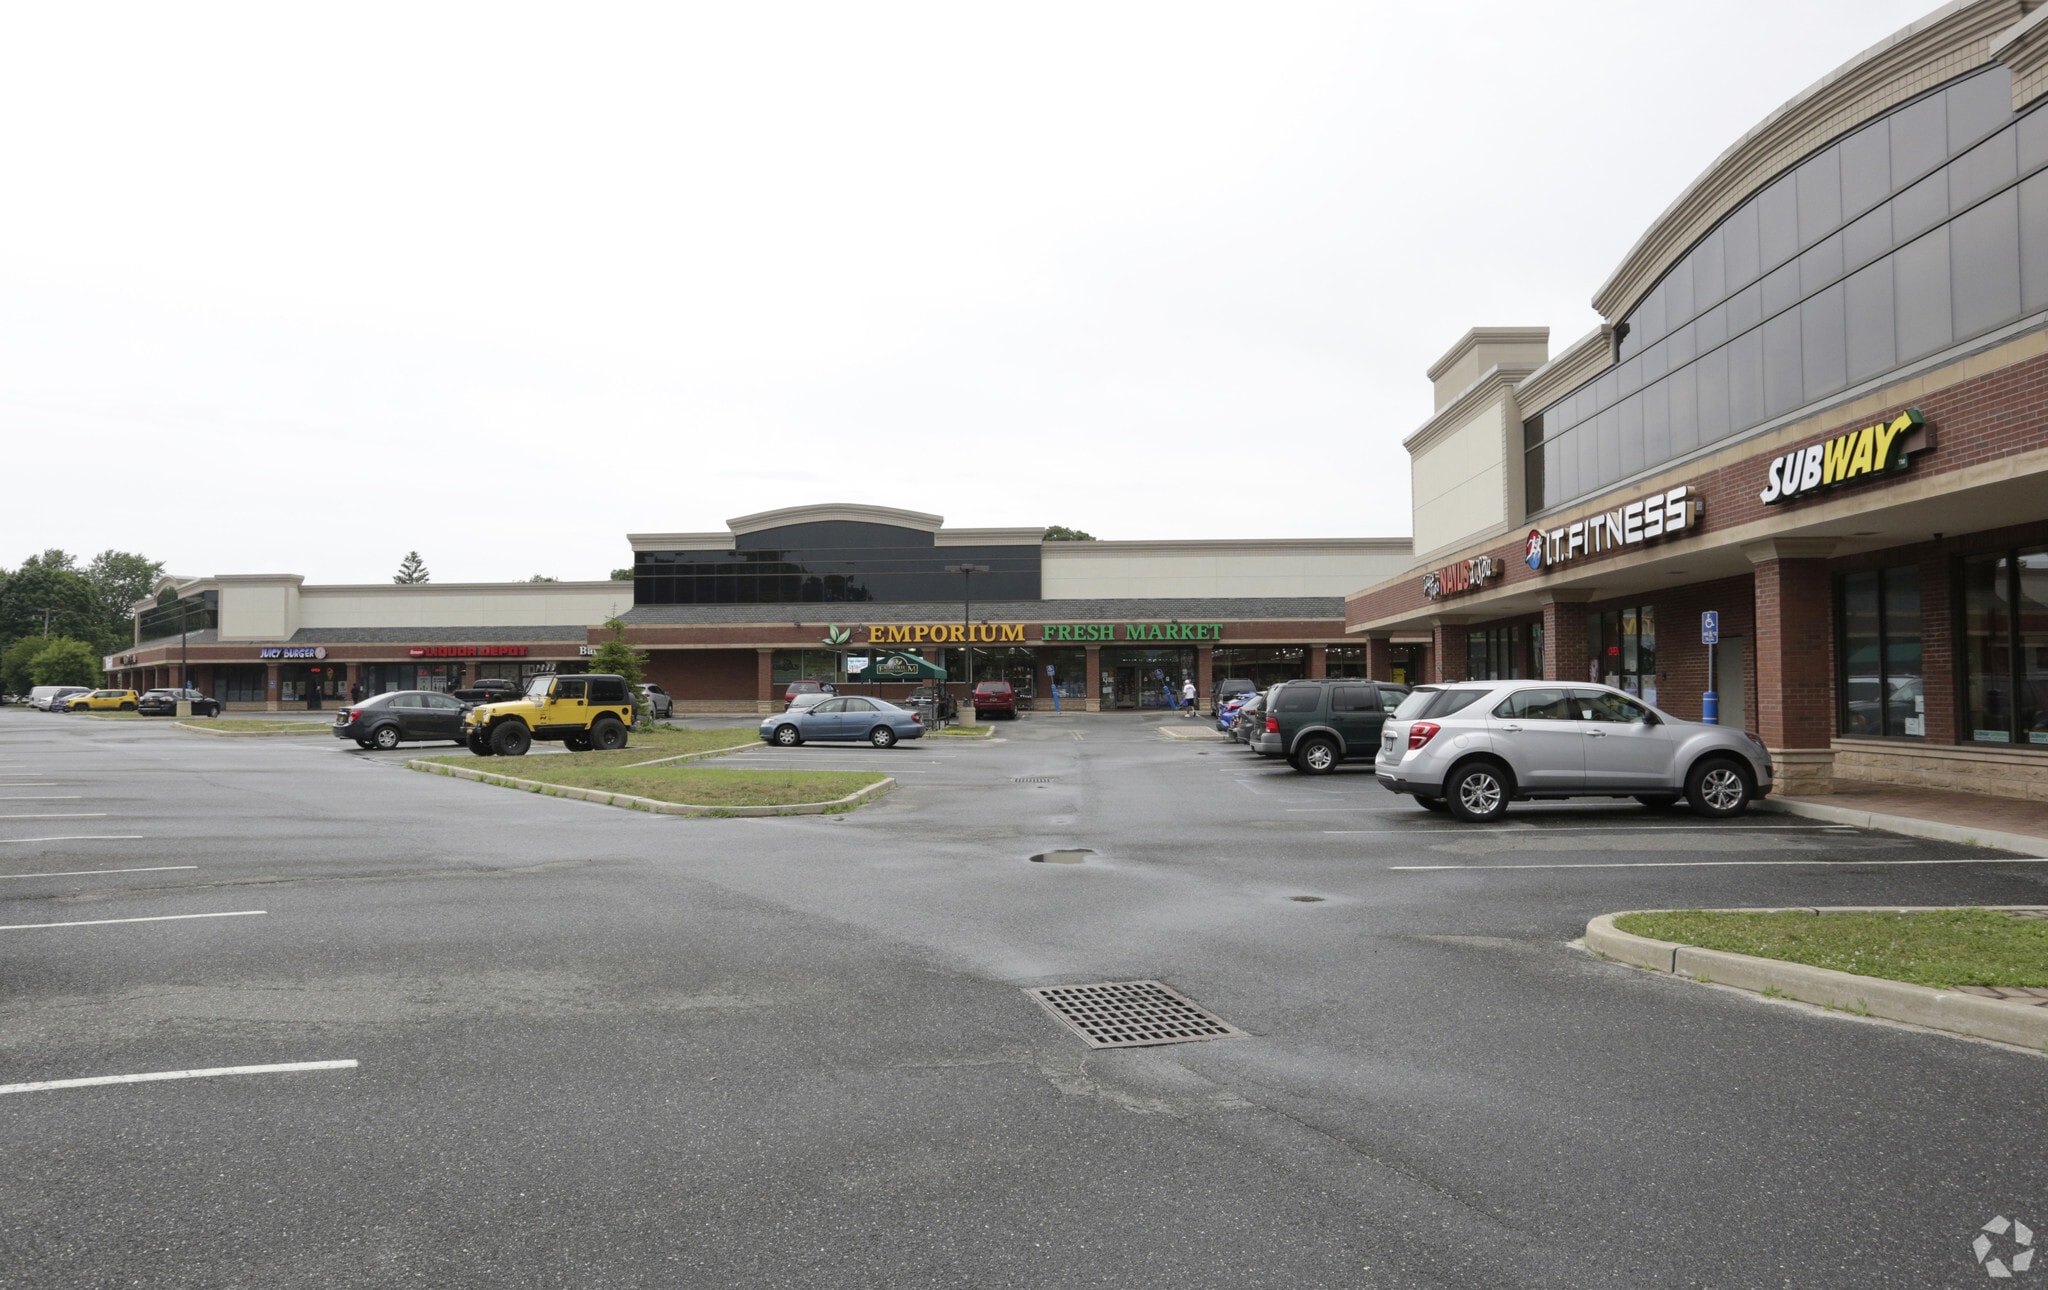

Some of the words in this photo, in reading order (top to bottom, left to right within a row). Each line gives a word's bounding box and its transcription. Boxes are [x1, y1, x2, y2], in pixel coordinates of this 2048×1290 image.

[1760, 410, 1912, 505] SUBWAY
[1569, 486, 1688, 560] FITNESS
[1440, 560, 1470, 596] NAILS
[868, 623, 1026, 643] EMPORIUM
[1043, 624, 1115, 641] FRESH
[1125, 623, 1224, 641] MARKET
[260, 647, 282, 658] JUICY
[284, 647, 315, 658] BURGER
[425, 646, 477, 657] LIQUOR
[480, 645, 528, 656] DEPOT
